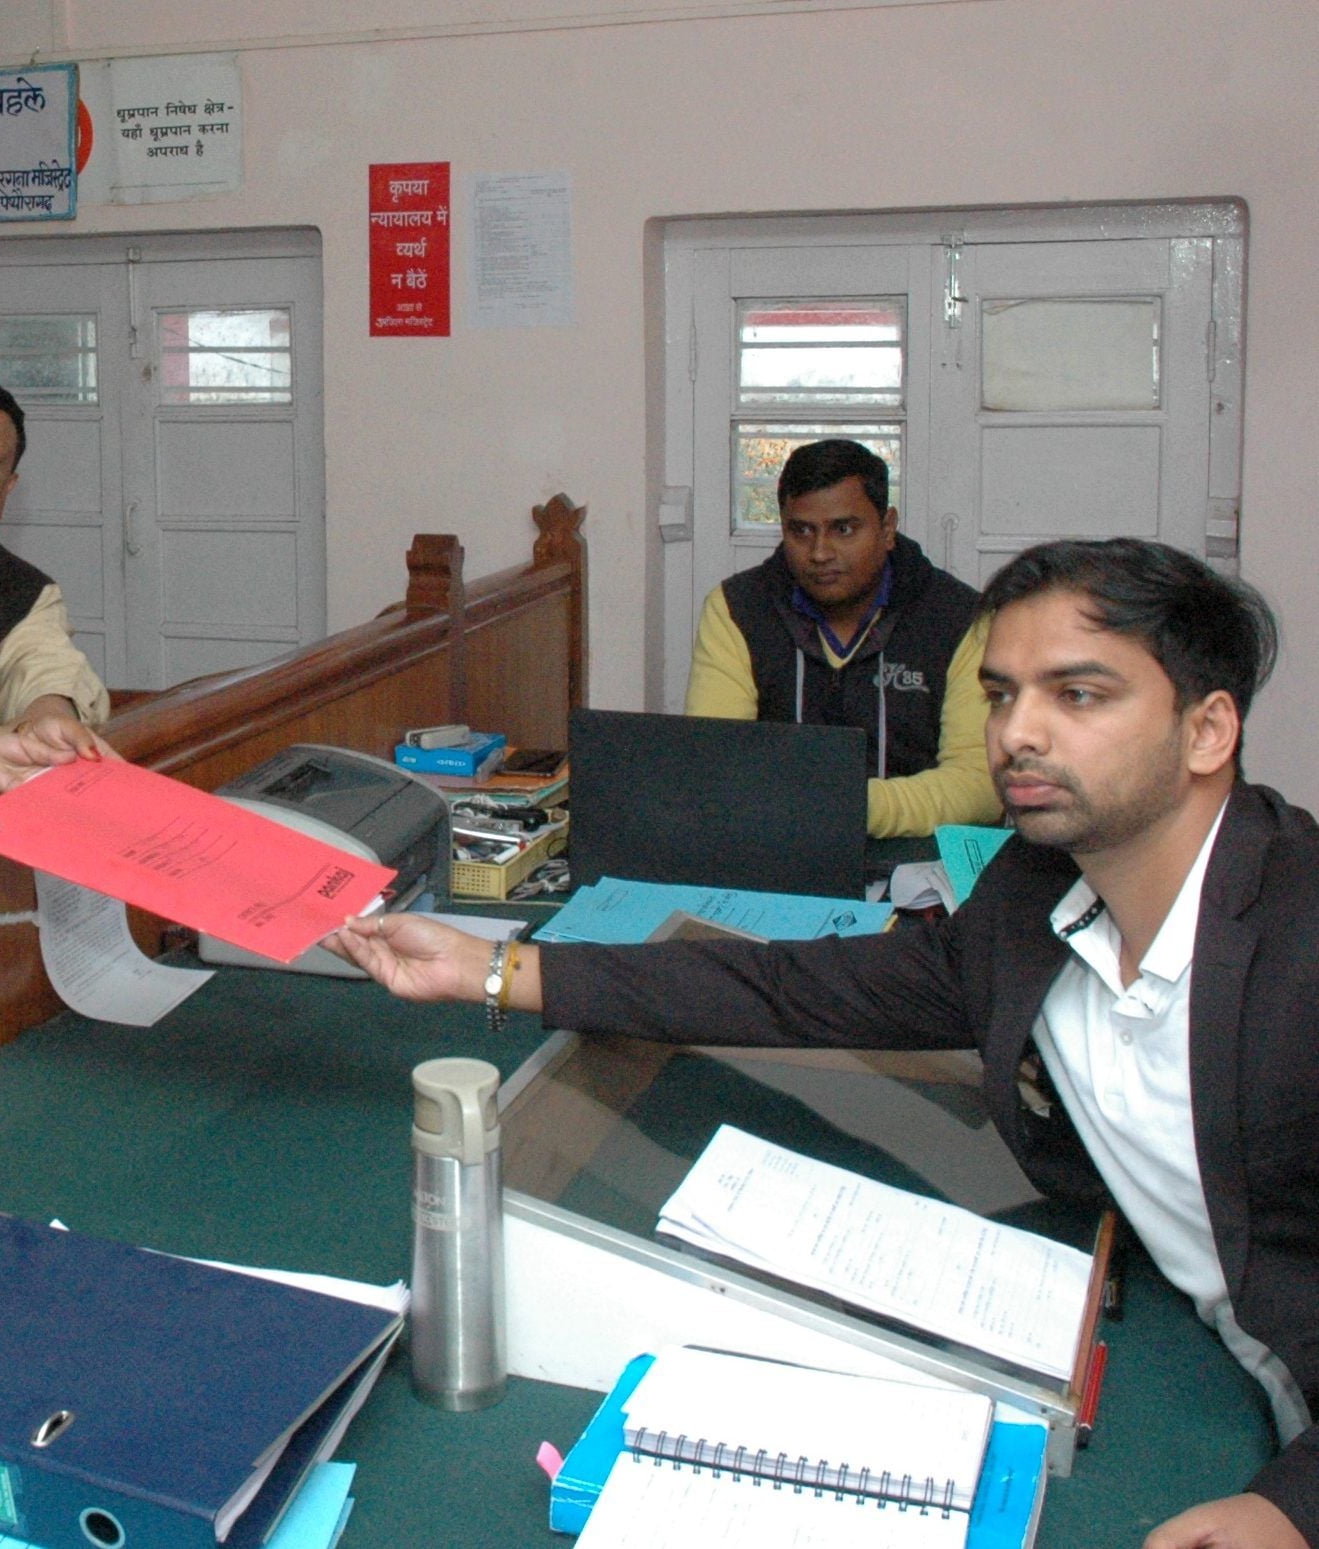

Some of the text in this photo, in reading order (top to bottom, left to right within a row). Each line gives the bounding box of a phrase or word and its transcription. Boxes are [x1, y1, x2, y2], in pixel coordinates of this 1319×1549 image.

[165, 100, 197, 116] निषेध
[198, 122, 230, 135] करना
[147, 140, 204, 158] अपराध है
[389, 179, 429, 203] कृपया
[370, 206, 449, 227] न्यायालय में
[396, 237, 427, 258] व्यर्थ
[391, 273, 403, 289] न
